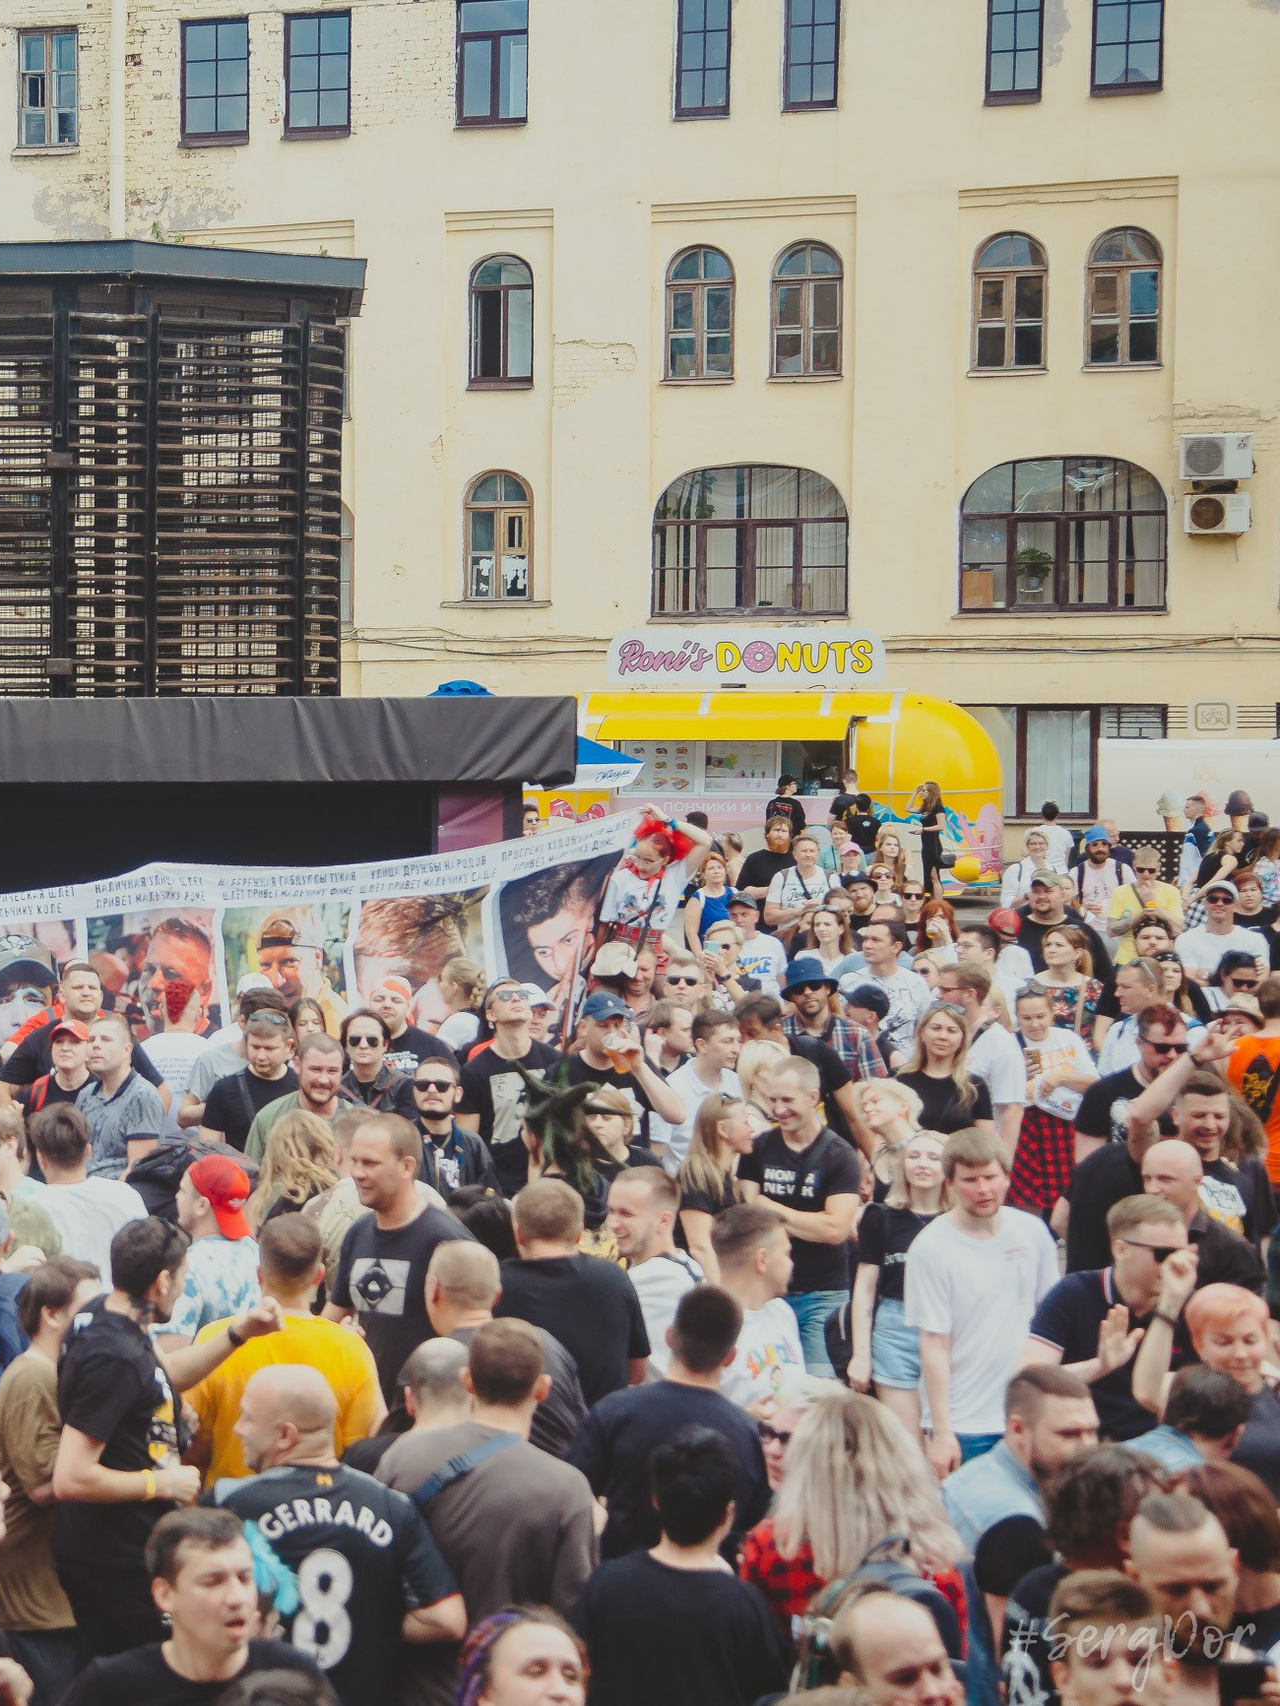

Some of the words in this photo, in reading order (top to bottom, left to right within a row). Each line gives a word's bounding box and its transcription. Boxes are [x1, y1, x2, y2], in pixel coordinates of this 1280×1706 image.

[618, 639, 713, 676] Roni's
[715, 639, 874, 674] DONUTS
[663, 801, 737, 813] ПОНЧИКИ
[741, 801, 752, 813] И
[370, 866, 400, 880] УЛИЦА
[403, 861, 442, 877] ДРУЖБЫ
[444, 854, 487, 871] НАРОДОВ
[96, 895, 132, 909] ПРИВЕТ
[763, 1181, 816, 1198] NEVR
[257, 1497, 394, 1548] GERRARD
[291, 1547, 354, 1670] 8
